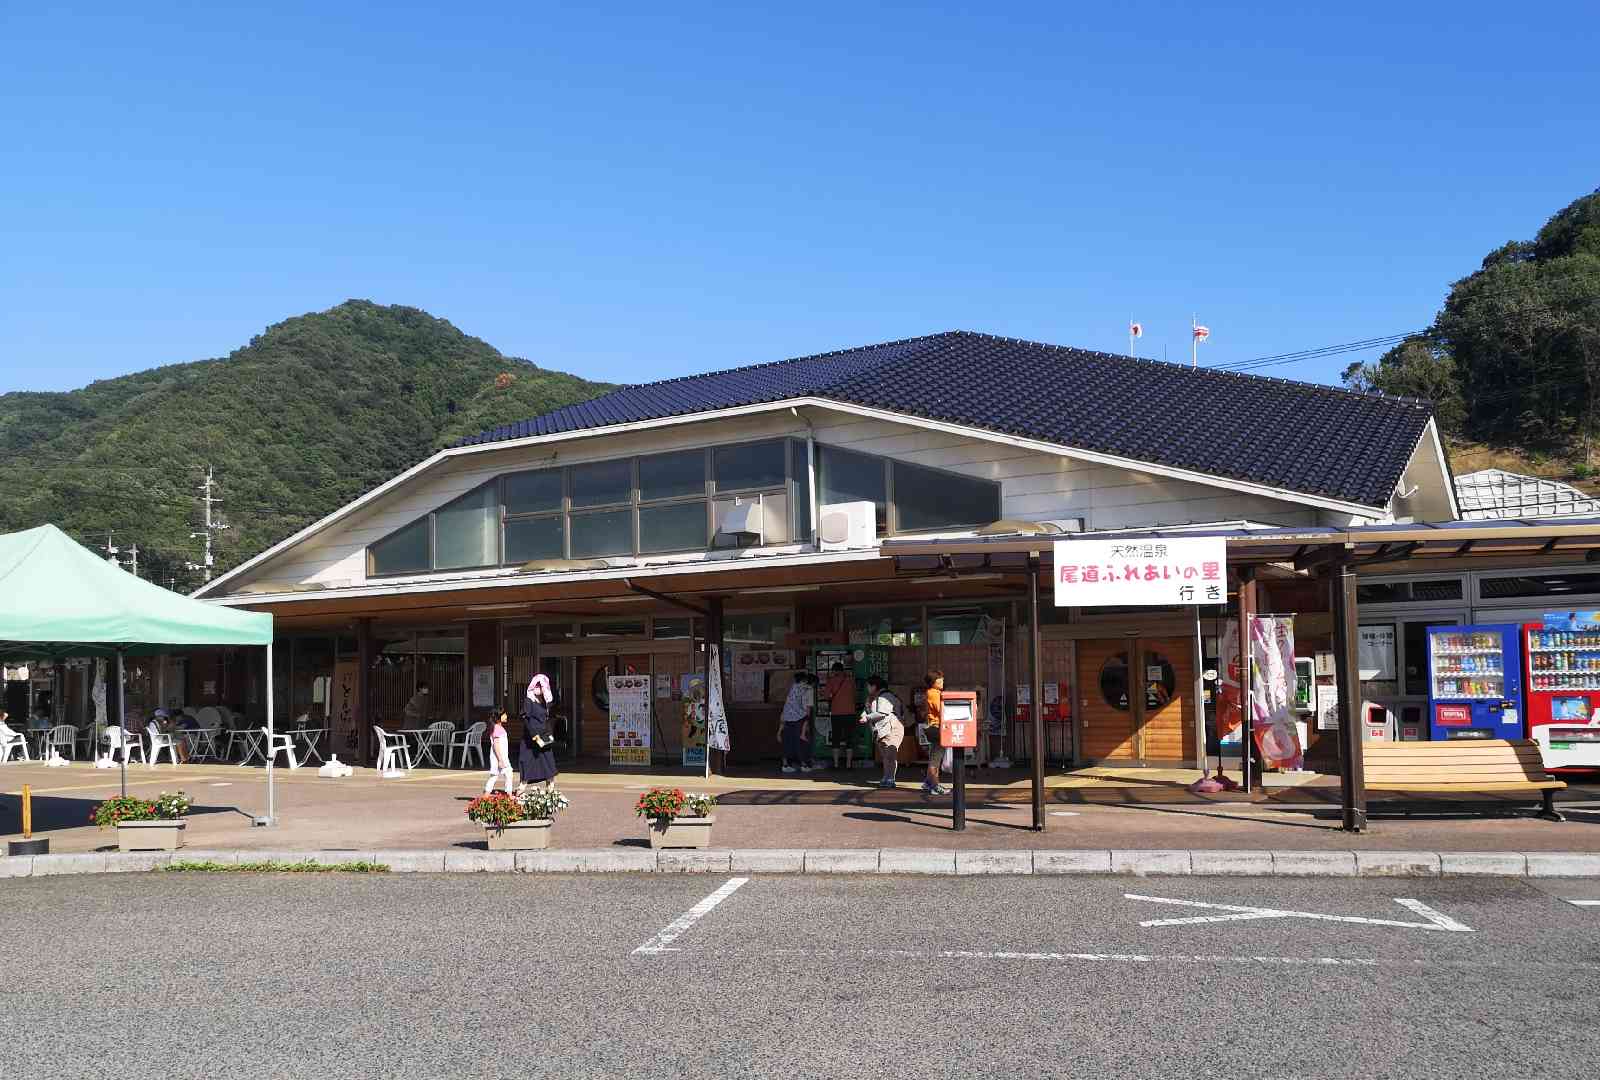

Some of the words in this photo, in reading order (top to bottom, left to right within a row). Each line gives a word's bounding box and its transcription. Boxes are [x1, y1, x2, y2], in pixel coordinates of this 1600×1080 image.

[1111, 544, 1168, 558] 天然温泉
[1060, 561, 1221, 583] 尾道ふれあいの里
[1179, 585, 1221, 601] 行き
